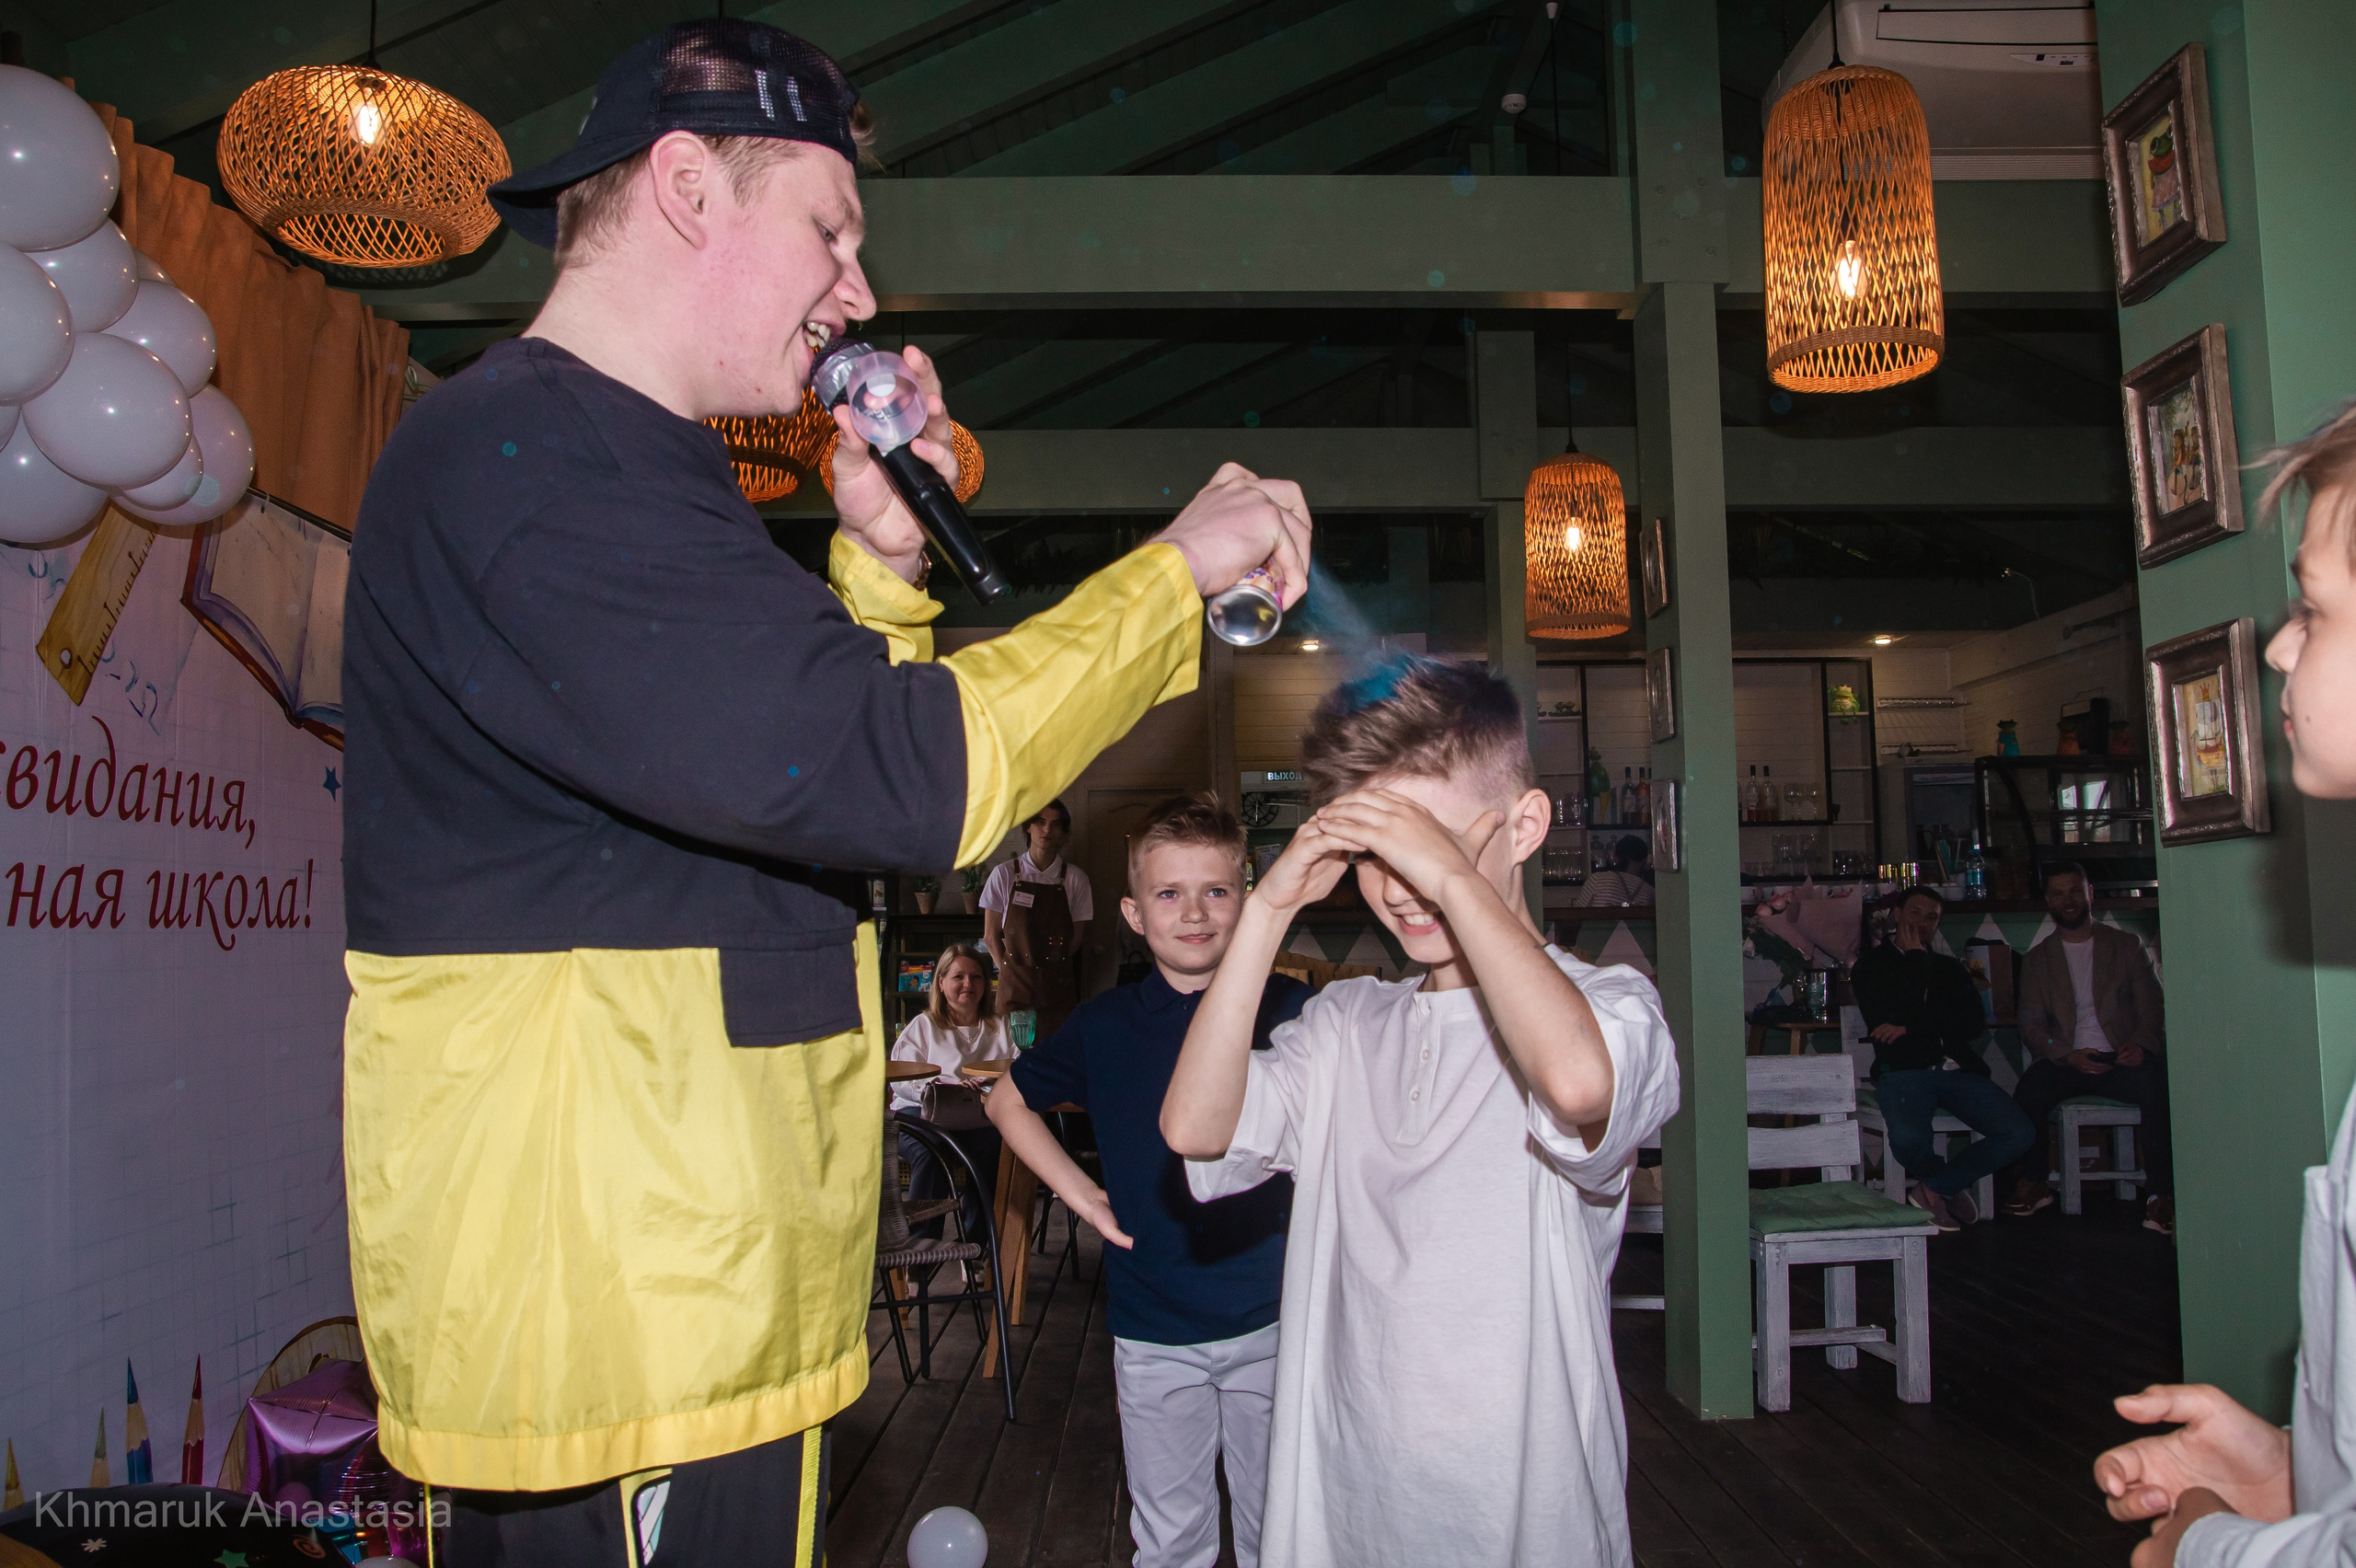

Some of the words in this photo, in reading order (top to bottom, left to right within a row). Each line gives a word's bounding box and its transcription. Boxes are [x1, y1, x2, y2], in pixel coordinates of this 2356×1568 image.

[1267, 771, 1302, 781] ВЫХОД
[6, 861, 126, 929] ная
[146, 858, 314, 951] школа!
